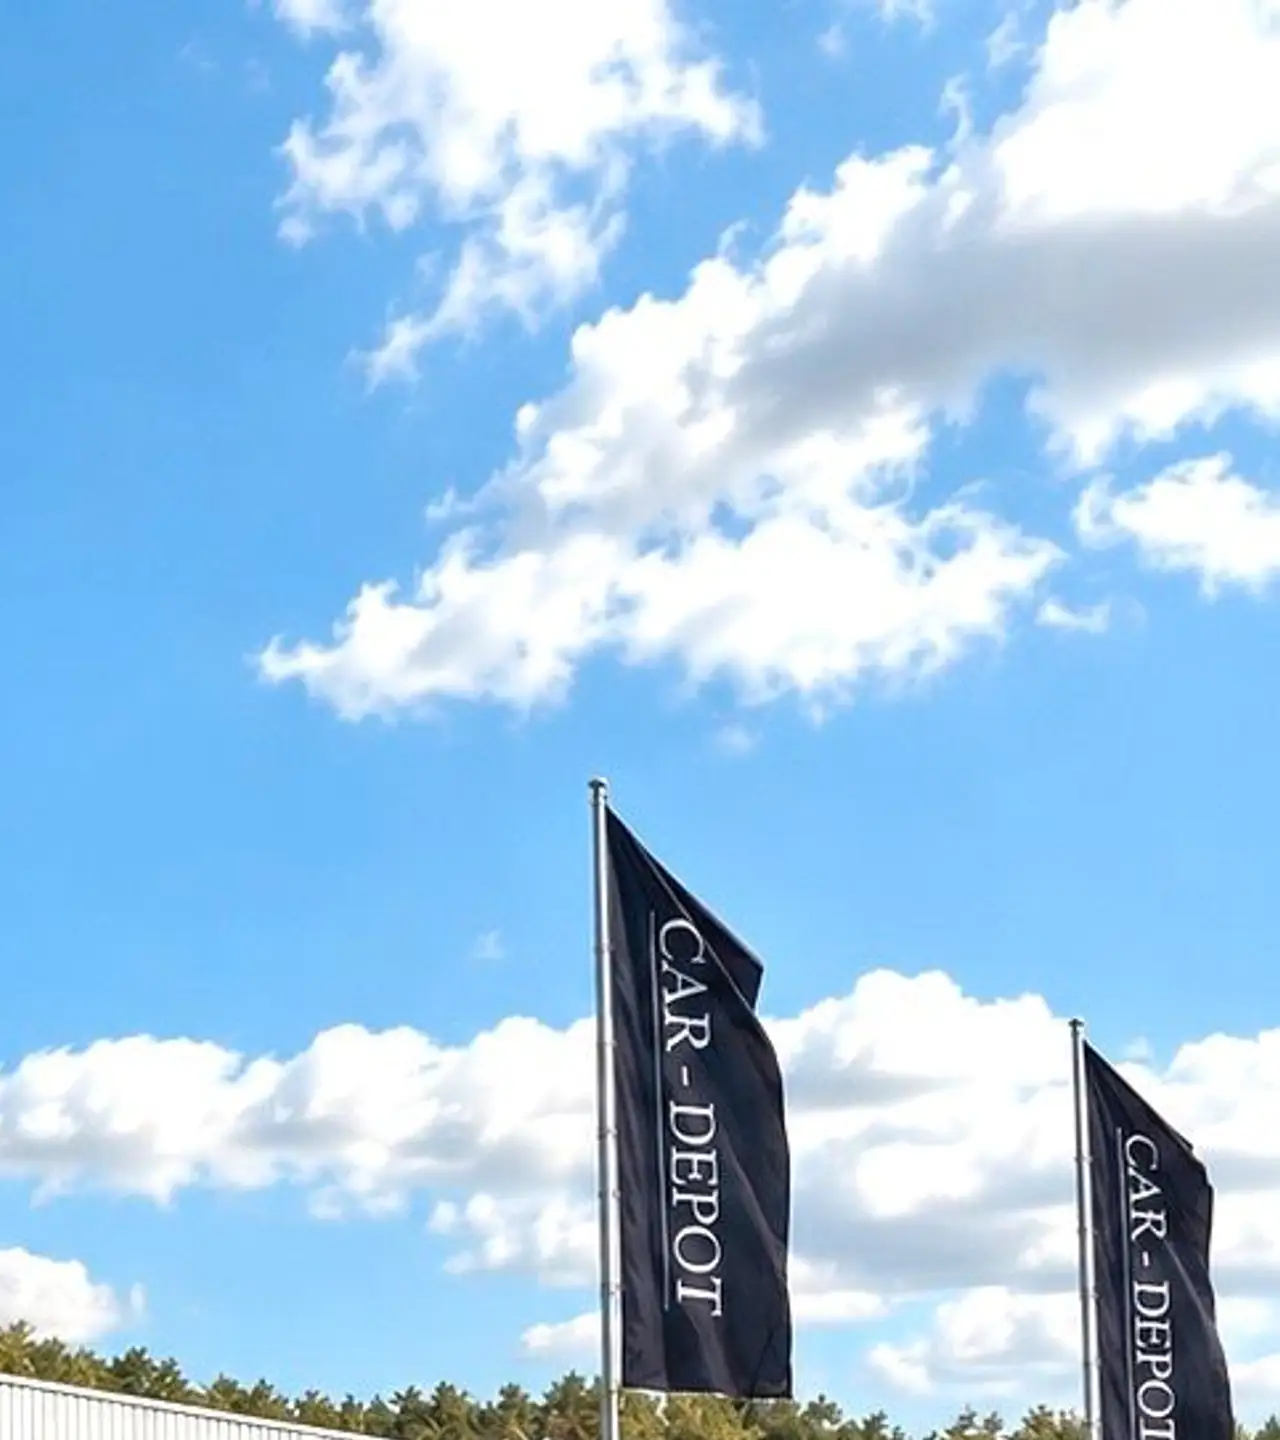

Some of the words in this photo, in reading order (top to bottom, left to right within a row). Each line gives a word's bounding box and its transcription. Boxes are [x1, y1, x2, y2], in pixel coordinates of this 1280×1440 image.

[658, 917, 713, 1054] CAR
[681, 1065, 691, 1086] -
[668, 1102, 723, 1317] DEPOT
[1124, 1133, 1168, 1243] CAR
